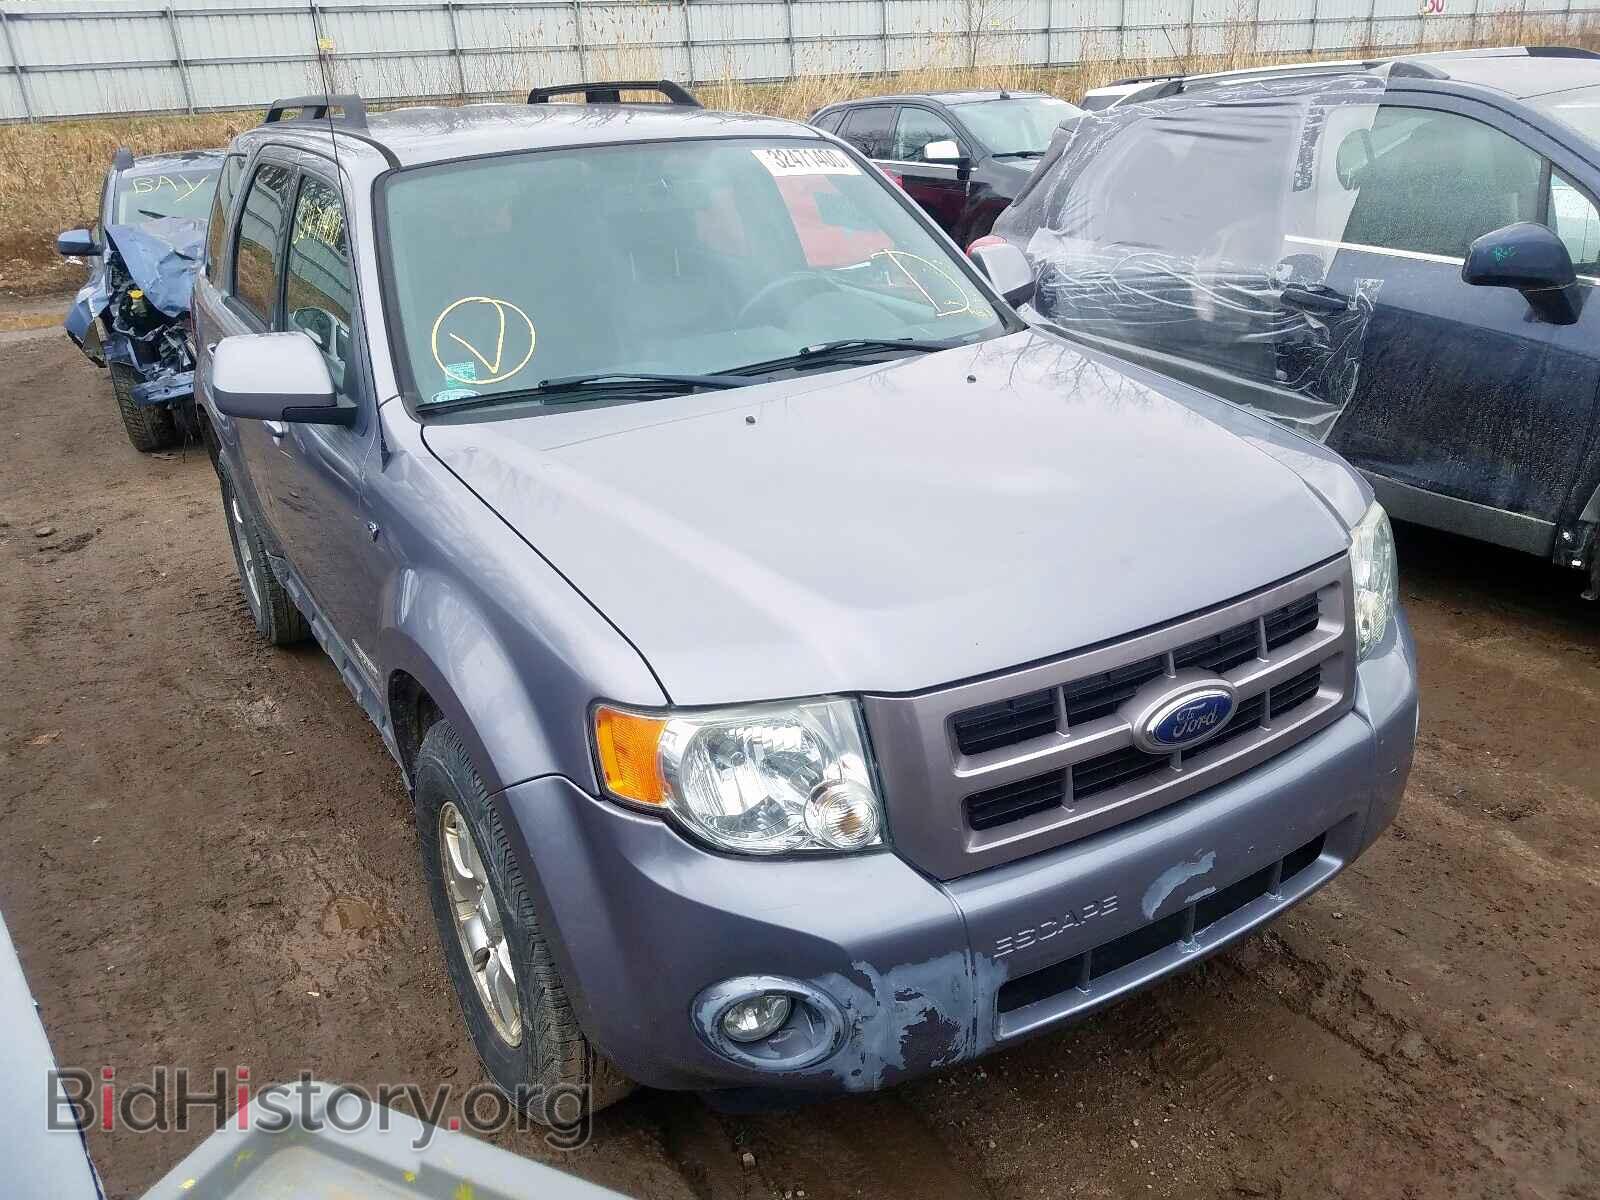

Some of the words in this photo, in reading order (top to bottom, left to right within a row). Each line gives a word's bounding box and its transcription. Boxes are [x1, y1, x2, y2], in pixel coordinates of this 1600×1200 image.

[133, 174, 209, 202] BAY
[1172, 702, 1219, 738] Ford
[992, 895, 1119, 958] ESCAPE
